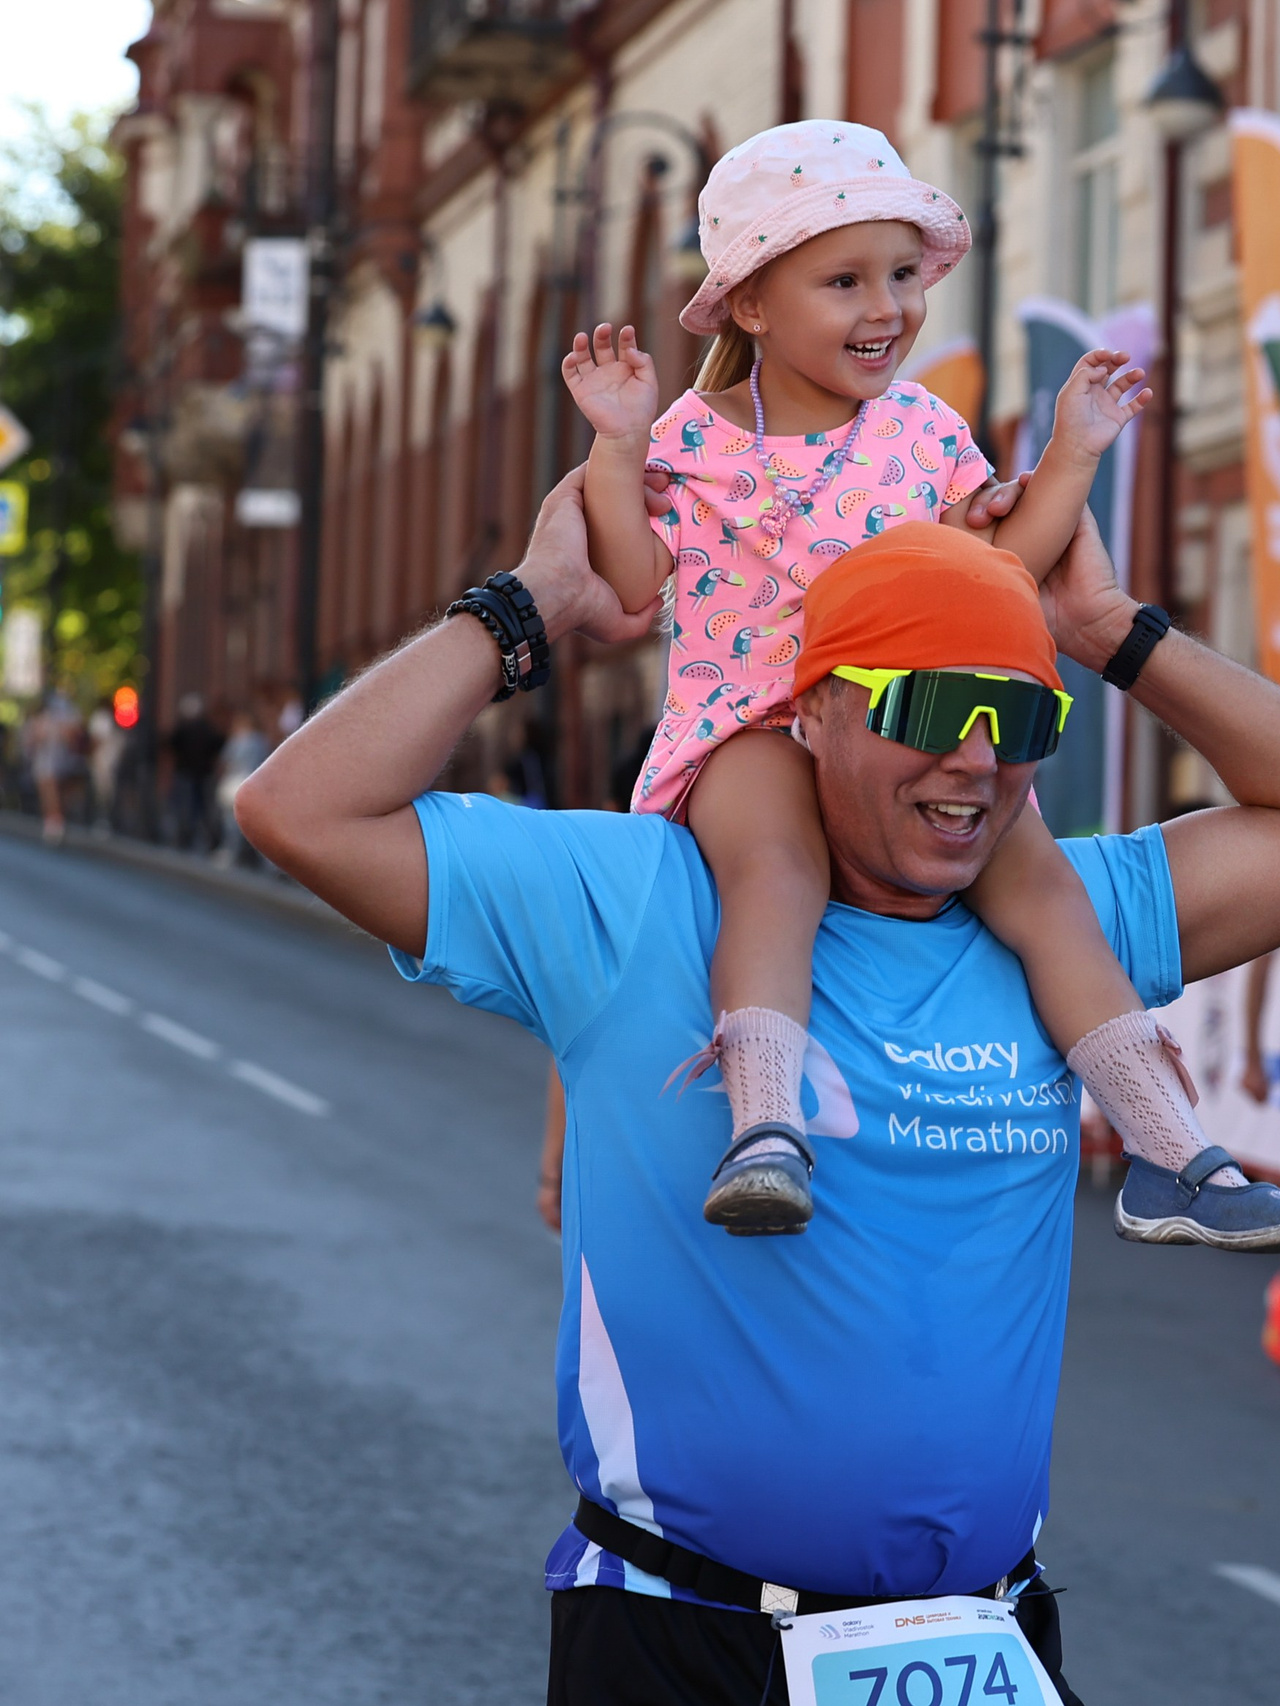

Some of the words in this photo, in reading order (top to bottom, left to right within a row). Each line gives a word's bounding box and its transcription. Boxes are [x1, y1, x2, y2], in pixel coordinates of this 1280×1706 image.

[888, 1112, 1068, 1155] Marathon
[842, 1619, 862, 1627] Galaxy
[895, 1615, 926, 1628] DNS
[849, 1651, 1018, 1706] 7074
